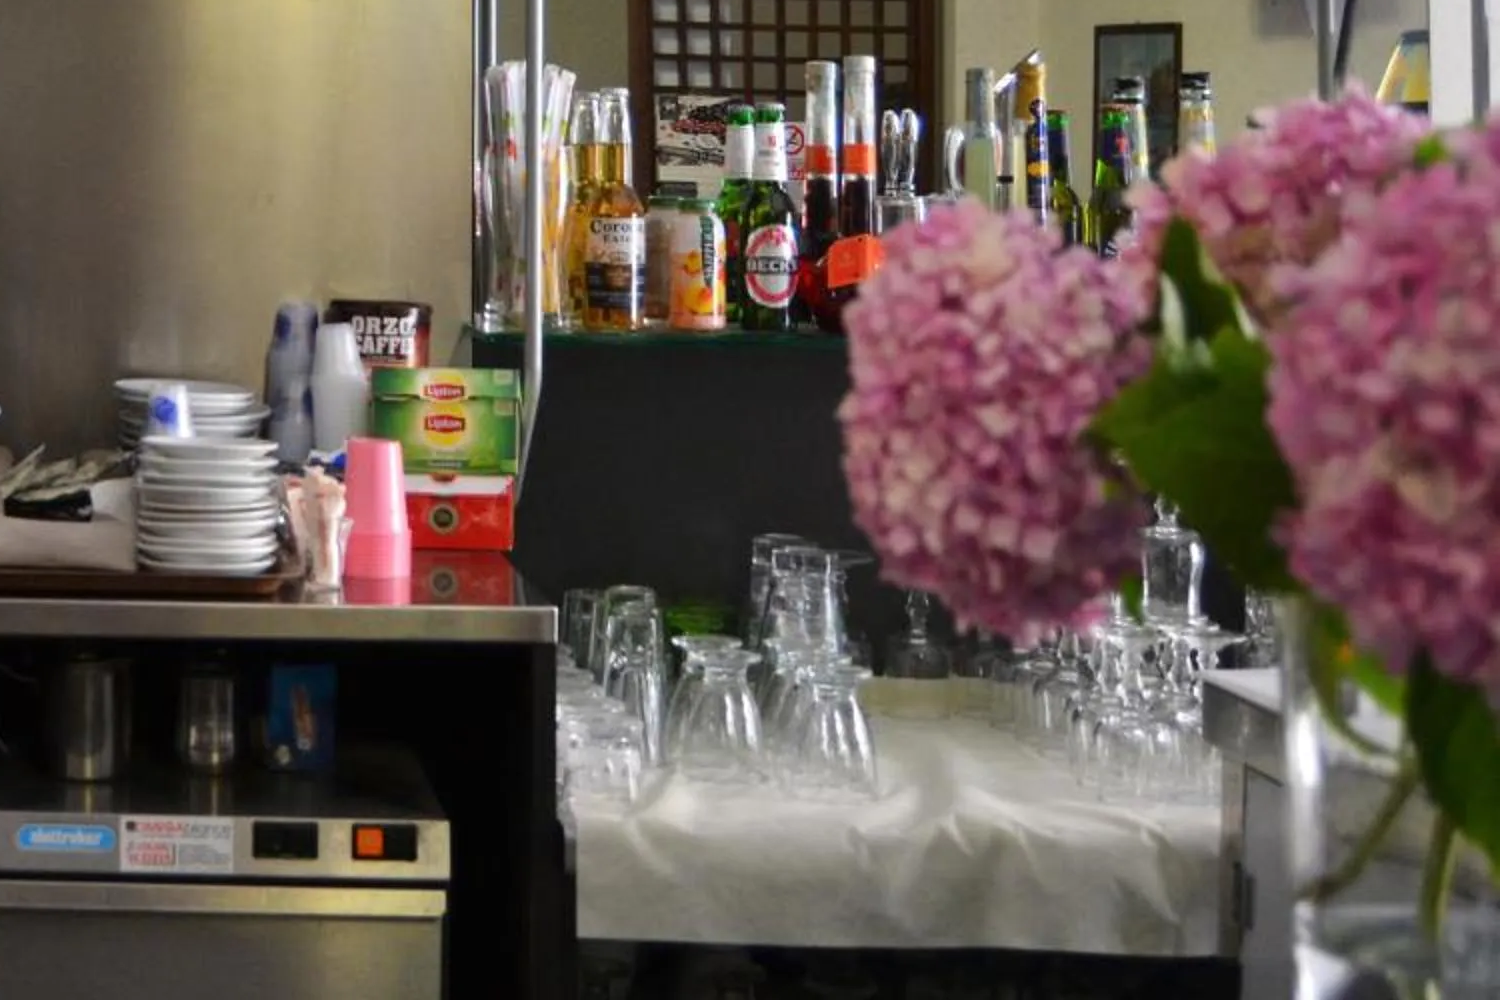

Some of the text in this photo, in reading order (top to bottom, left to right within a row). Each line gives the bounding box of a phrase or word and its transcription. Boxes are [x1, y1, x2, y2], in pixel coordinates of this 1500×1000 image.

[590, 214, 644, 233] Coroa
[352, 315, 416, 336] ORZO
[428, 386, 461, 398] Lipton
[428, 419, 461, 431] Lipton
